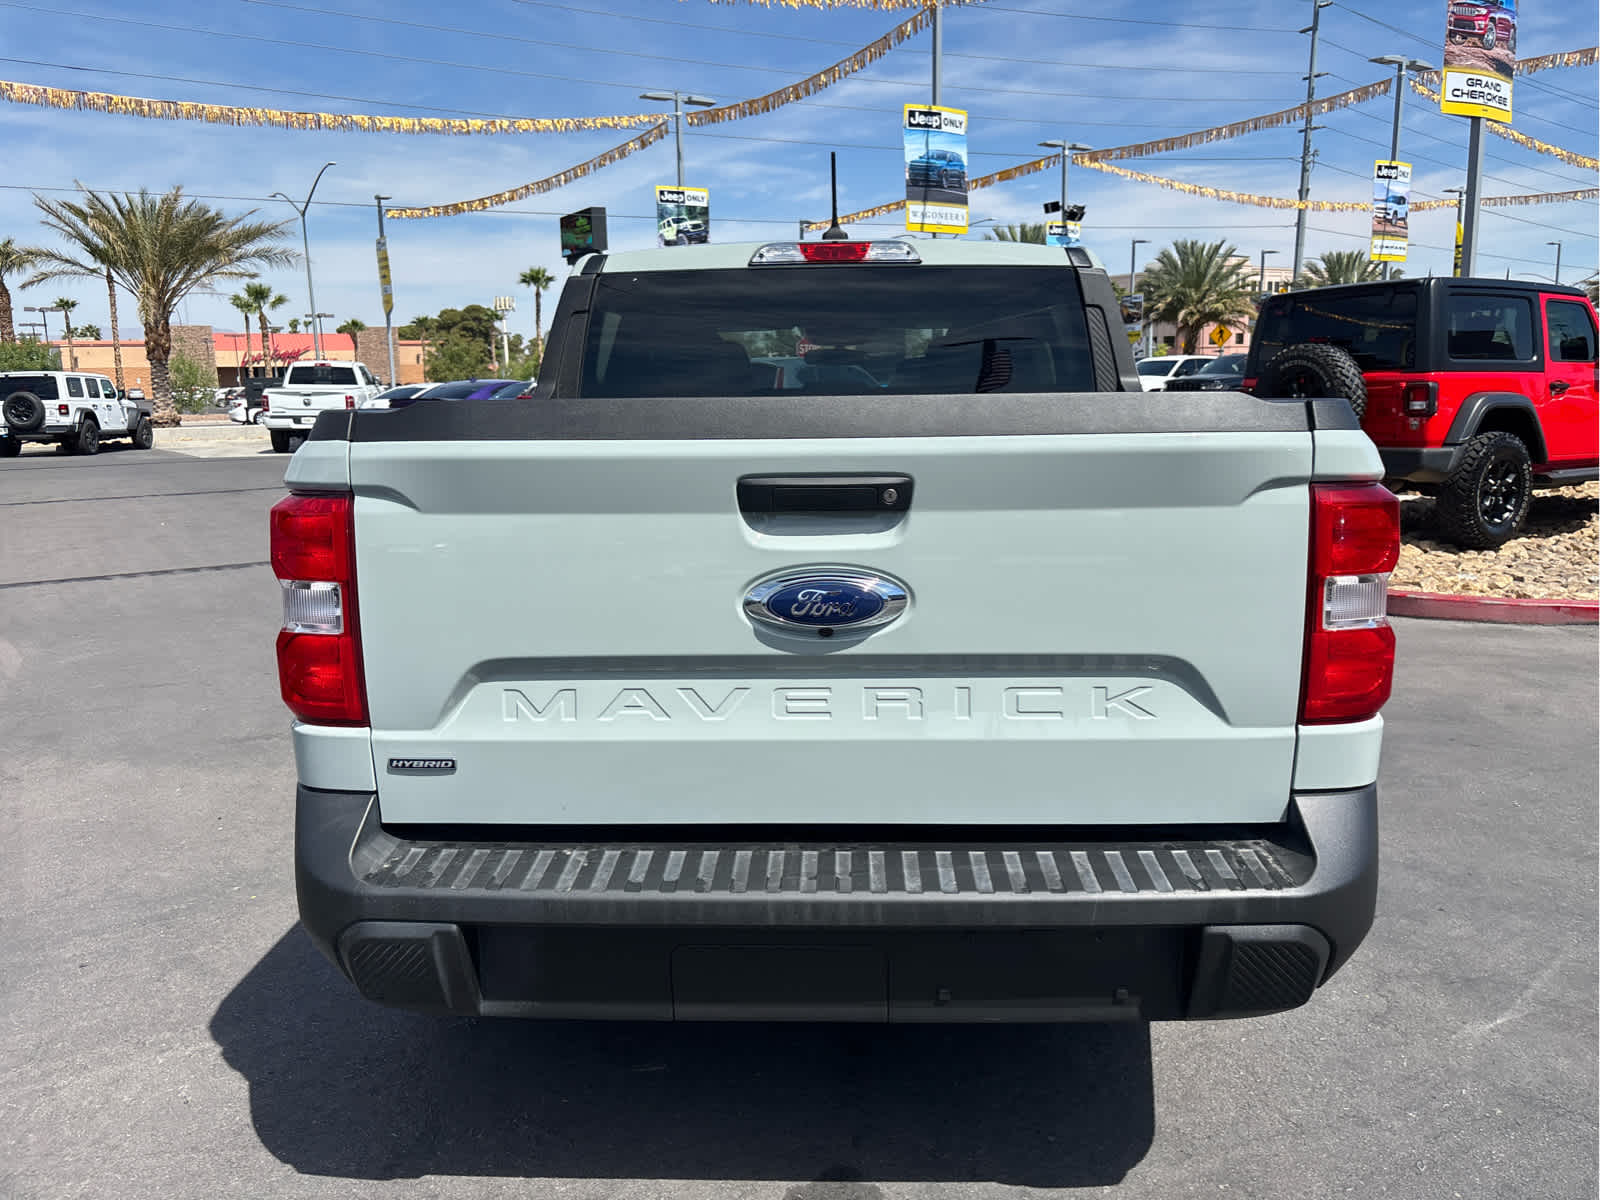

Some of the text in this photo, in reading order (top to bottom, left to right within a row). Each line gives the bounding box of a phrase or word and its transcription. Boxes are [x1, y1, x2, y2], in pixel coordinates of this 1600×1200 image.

[1466, 78, 1502, 93] GRAND
[1451, 88, 1508, 107] CHEROKEE
[910, 111, 963, 130] Jeep ONLY
[1378, 166, 1398, 179] Jeep
[660, 191, 684, 202] Jeep
[791, 589, 858, 617] Ford
[502, 685, 1159, 722] MAVERICK
[391, 760, 453, 768] HYBRID
